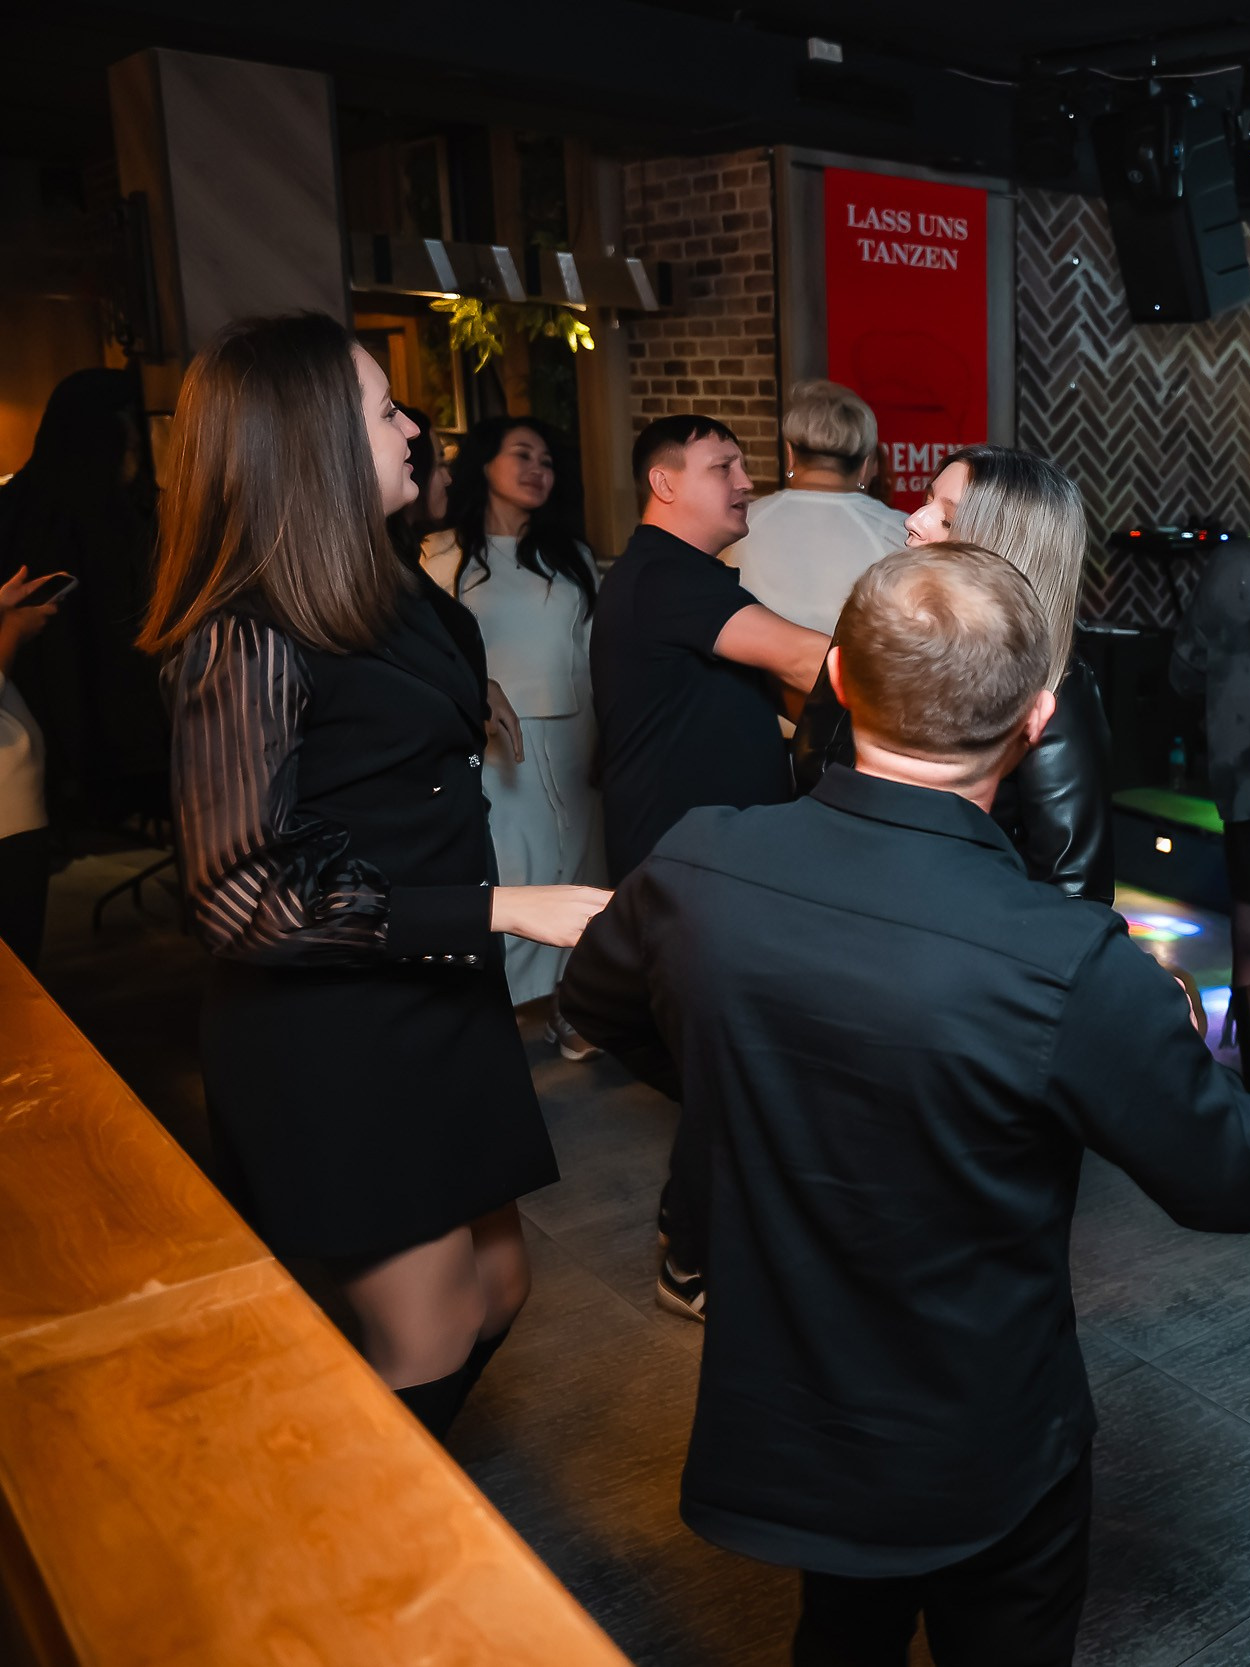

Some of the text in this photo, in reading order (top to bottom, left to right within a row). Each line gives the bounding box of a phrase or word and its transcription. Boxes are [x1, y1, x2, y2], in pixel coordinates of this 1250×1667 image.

[846, 203, 968, 241] LASS UNS
[856, 237, 959, 271] TANZEN
